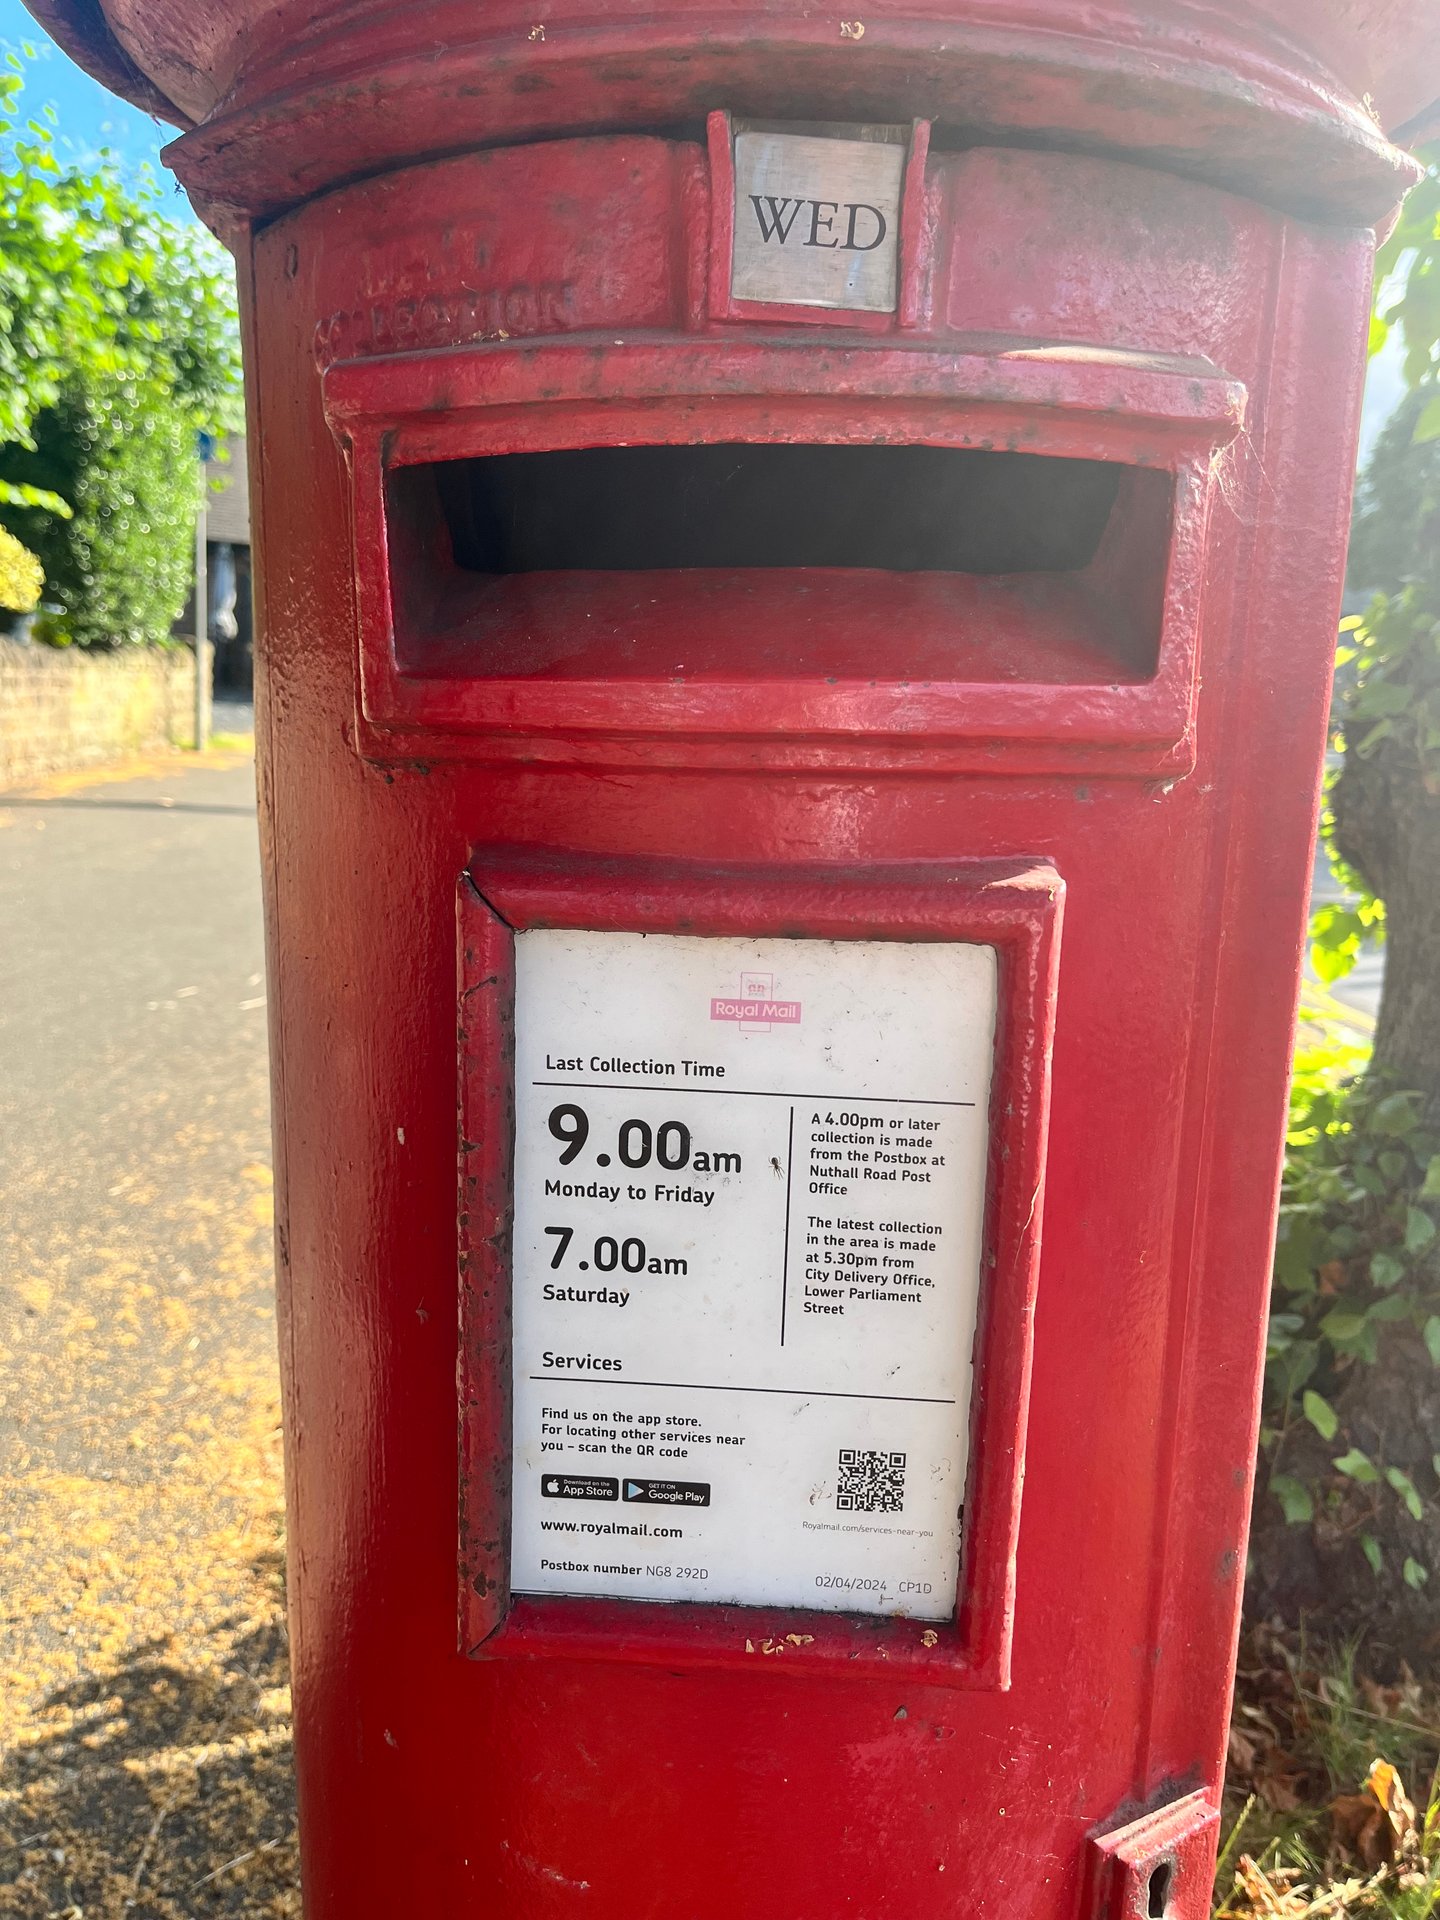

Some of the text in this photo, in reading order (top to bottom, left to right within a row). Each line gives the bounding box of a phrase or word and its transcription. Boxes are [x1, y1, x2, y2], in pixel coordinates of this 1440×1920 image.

[748, 195, 887, 251] WED
[715, 1002, 796, 1018] Royal Mail
[546, 1055, 725, 1077] Last Collection Time
[811, 1112, 940, 1131] A 4.00pm or later
[548, 1104, 742, 1173] 9.00am
[811, 1132, 932, 1148] collection is made
[810, 1149, 945, 1166] from the Postbox at
[810, 1165, 931, 1182] Nuthall Road Post
[545, 1179, 715, 1207] Monday to Friday
[809, 1183, 847, 1195] Office
[808, 1217, 942, 1234] The latest collection
[544, 1226, 688, 1276] 7.00am
[806, 1233, 936, 1251] in the area is made
[806, 1252, 914, 1269] at 5.30pm from
[805, 1269, 935, 1288] City Delivery Office,
[543, 1284, 630, 1307] Saturday
[804, 1285, 921, 1302] Lower Parliament
[804, 1302, 844, 1315] Street
[542, 1352, 622, 1371] Services
[542, 1408, 702, 1427] Find us on the app store.
[542, 1424, 745, 1446] For locating other services near
[541, 1441, 563, 1453] you
[578, 1443, 606, 1454] scan
[612, 1443, 632, 1454] the
[637, 1444, 654, 1456] QR
[659, 1446, 688, 1458] code
[563, 1485, 613, 1496] App Store
[649, 1490, 704, 1503] Google Play
[541, 1519, 683, 1538] www.royalmail.com
[802, 1521, 933, 1537] Royalmail.com/services-near-you
[541, 1559, 708, 1579] Postbox number NG8 292D
[815, 1576, 932, 1594] 02/04/2024 CP1D
